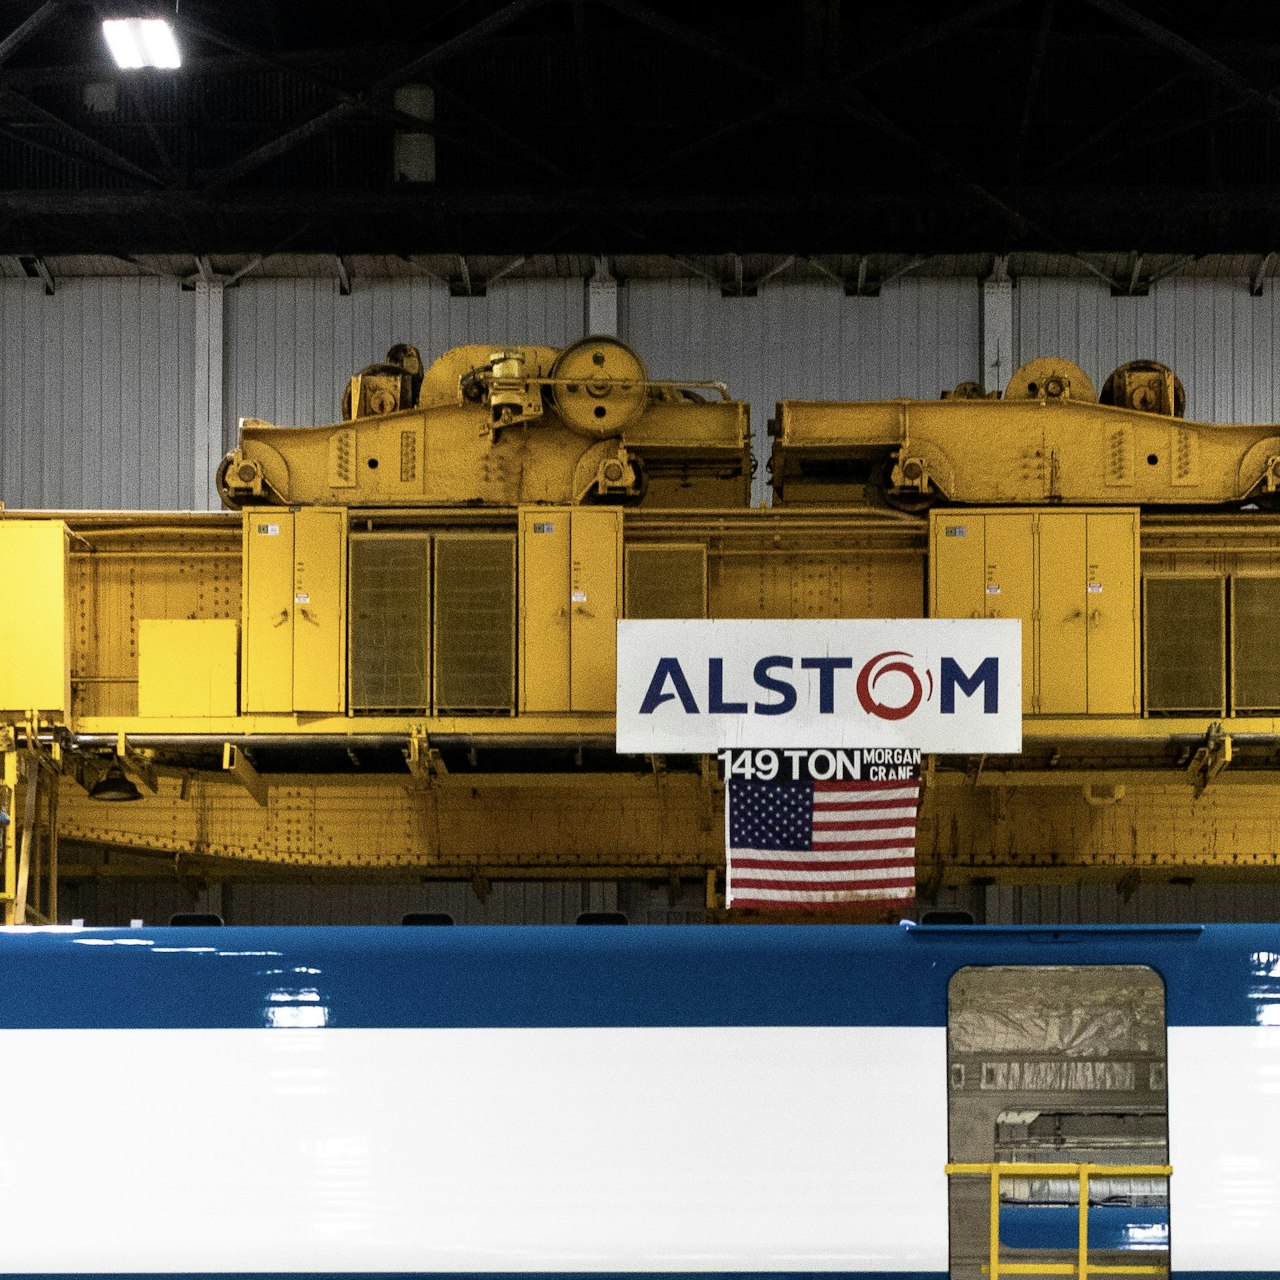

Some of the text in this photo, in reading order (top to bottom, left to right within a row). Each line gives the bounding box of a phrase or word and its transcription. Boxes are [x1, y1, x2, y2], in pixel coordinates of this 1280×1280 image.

[639, 651, 999, 721] ALSTOM
[717, 749, 861, 781] 149 TON
[863, 748, 921, 765] MORGAN
